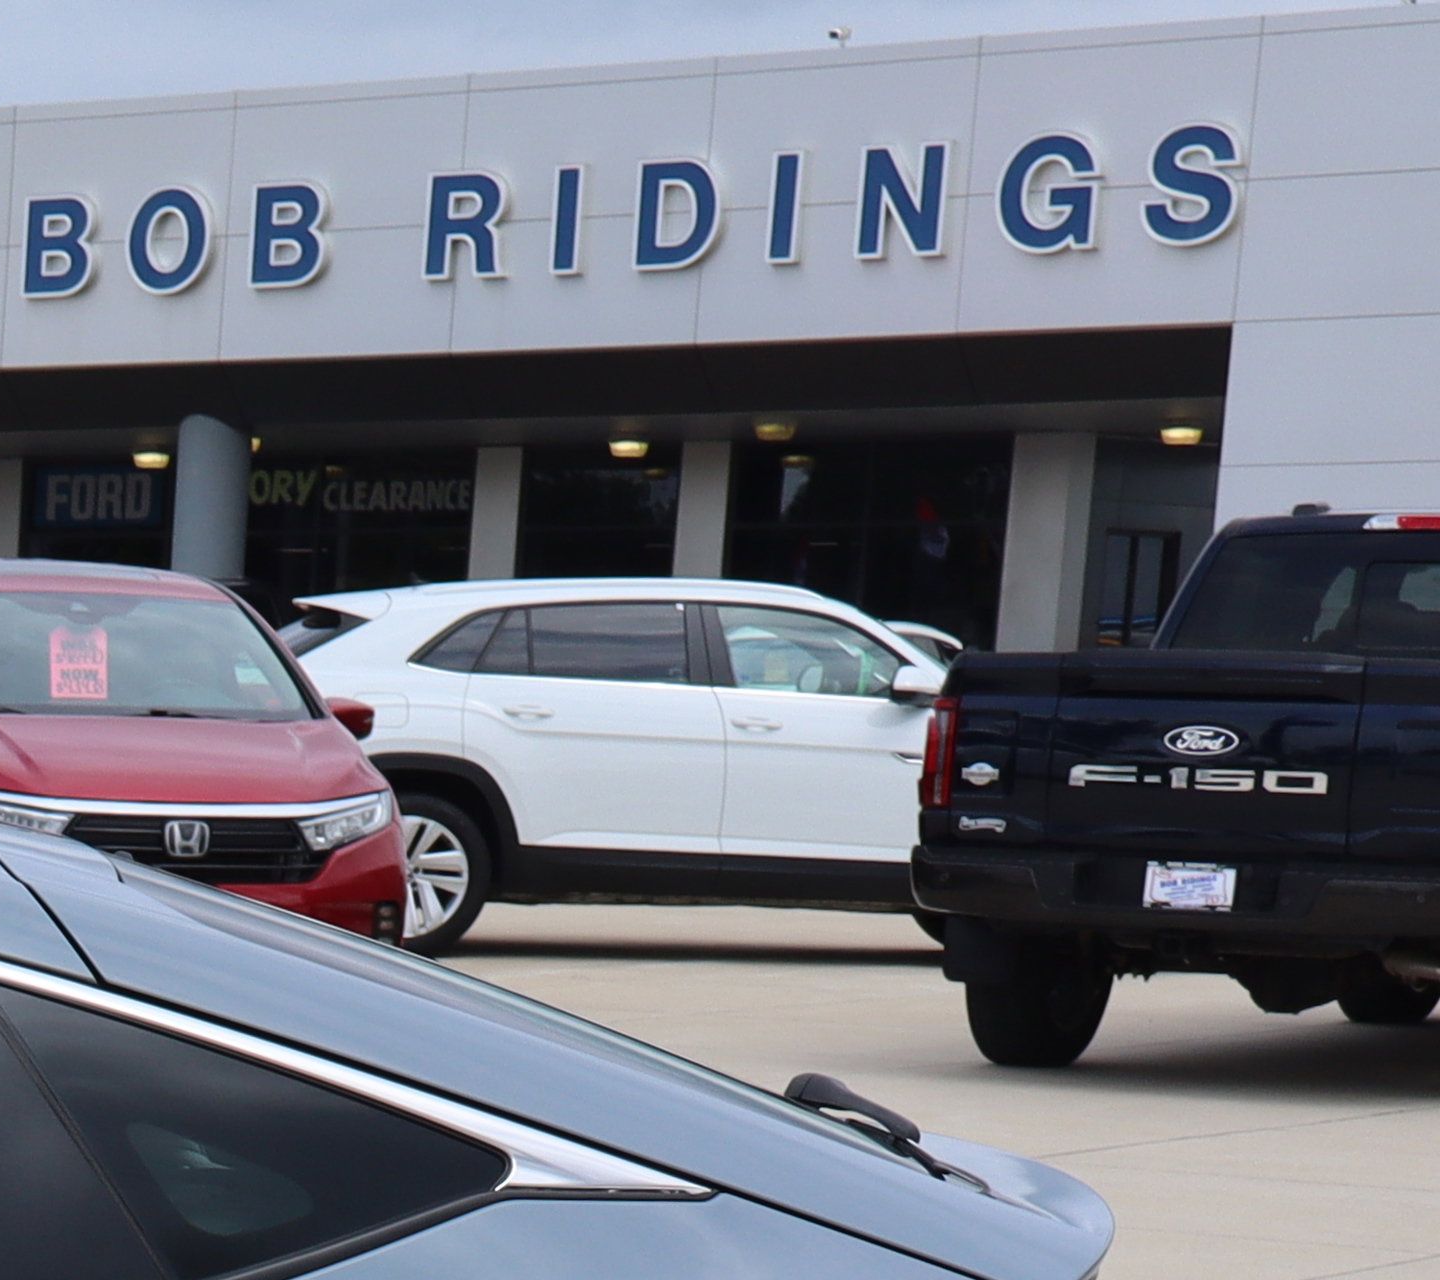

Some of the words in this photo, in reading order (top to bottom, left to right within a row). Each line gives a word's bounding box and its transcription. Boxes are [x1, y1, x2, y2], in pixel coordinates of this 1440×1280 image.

[20, 180, 332, 299] BOB
[419, 120, 1247, 282] RIDINGS
[45, 472, 152, 521] FORD
[322, 478, 472, 513] CLEARANCE
[60, 668, 99, 681] NOW
[1175, 728, 1227, 751] Ford
[1067, 763, 1330, 795] F-150
